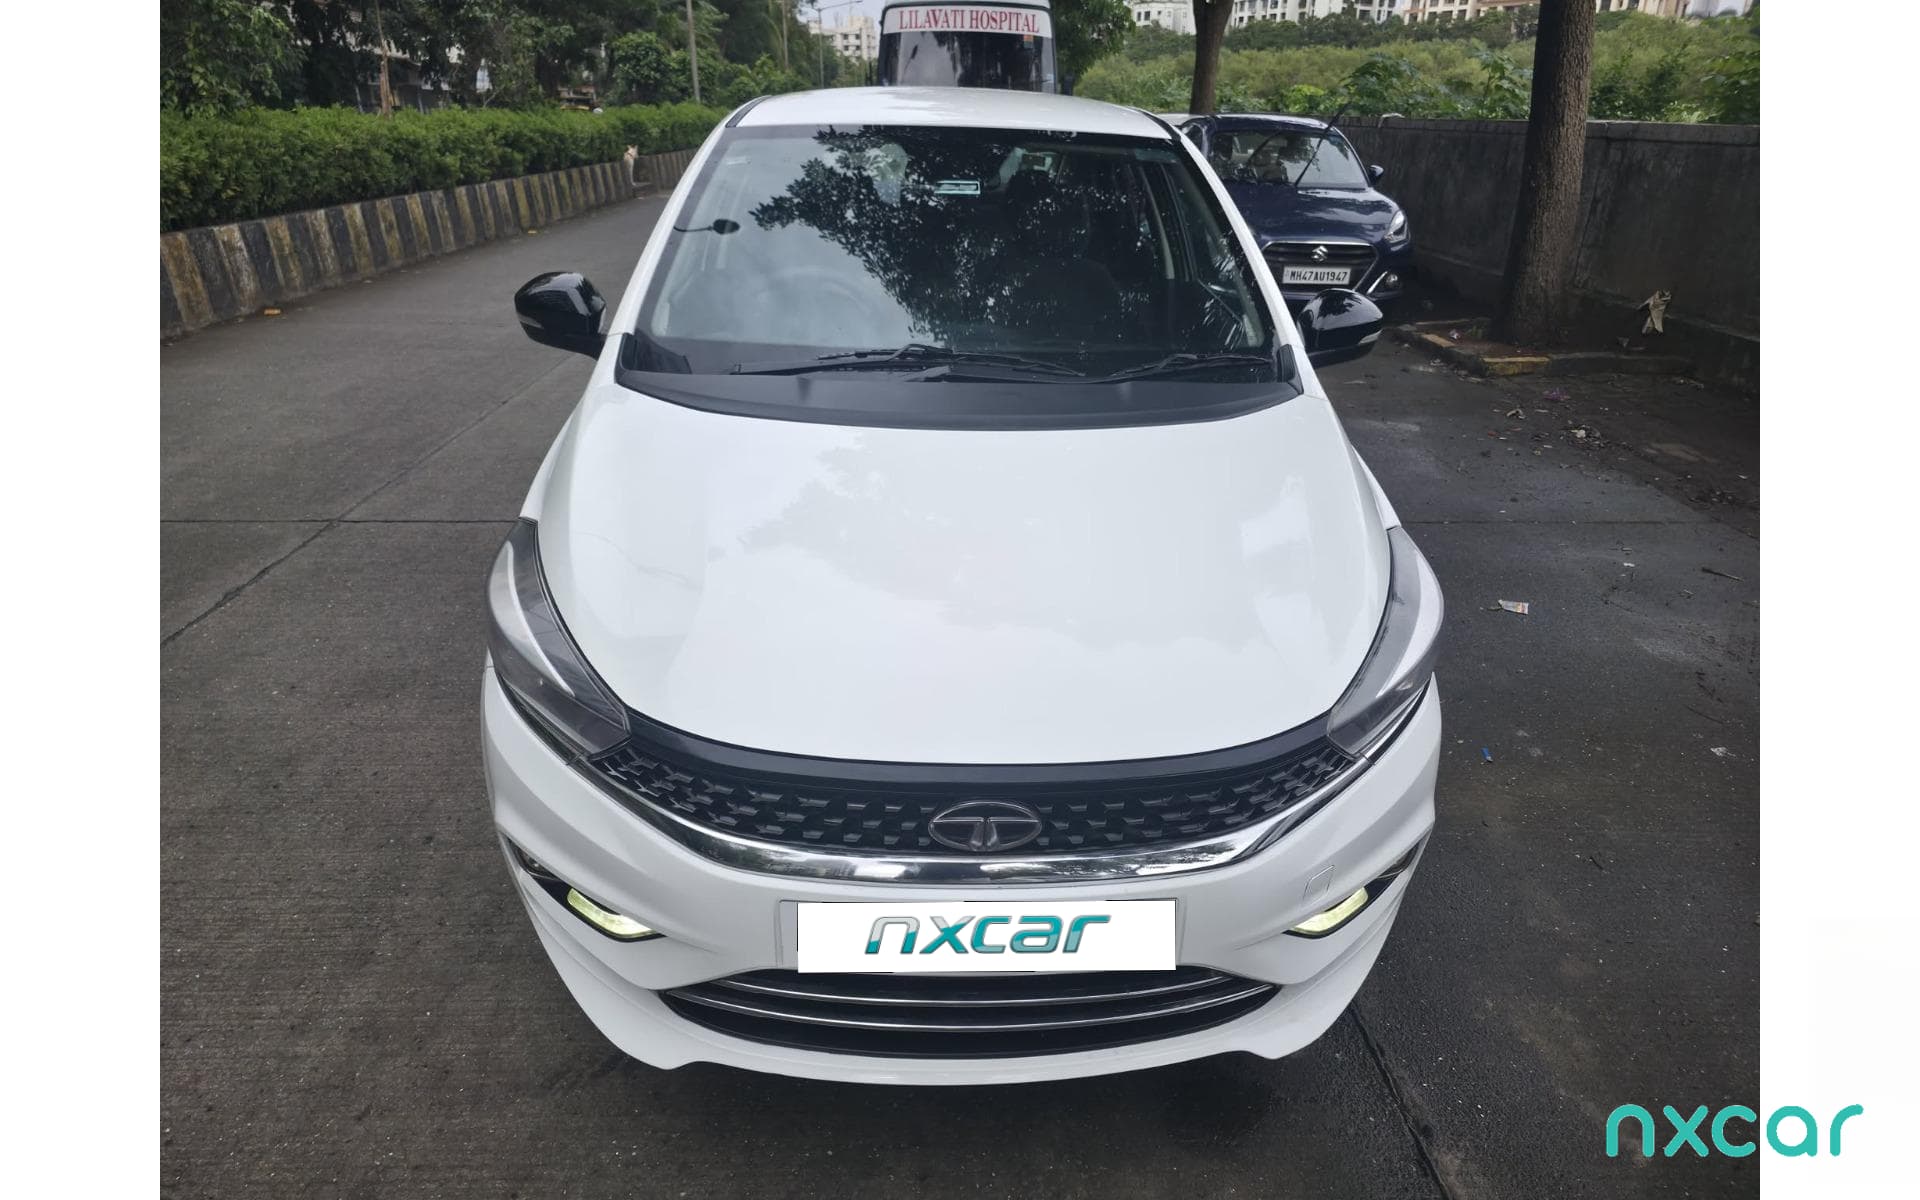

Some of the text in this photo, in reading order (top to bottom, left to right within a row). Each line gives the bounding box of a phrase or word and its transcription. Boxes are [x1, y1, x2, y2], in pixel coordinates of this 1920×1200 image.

[899, 9, 1040, 33] LILAVATI HOSPITAL
[1289, 270, 1348, 282] MH47AU1947
